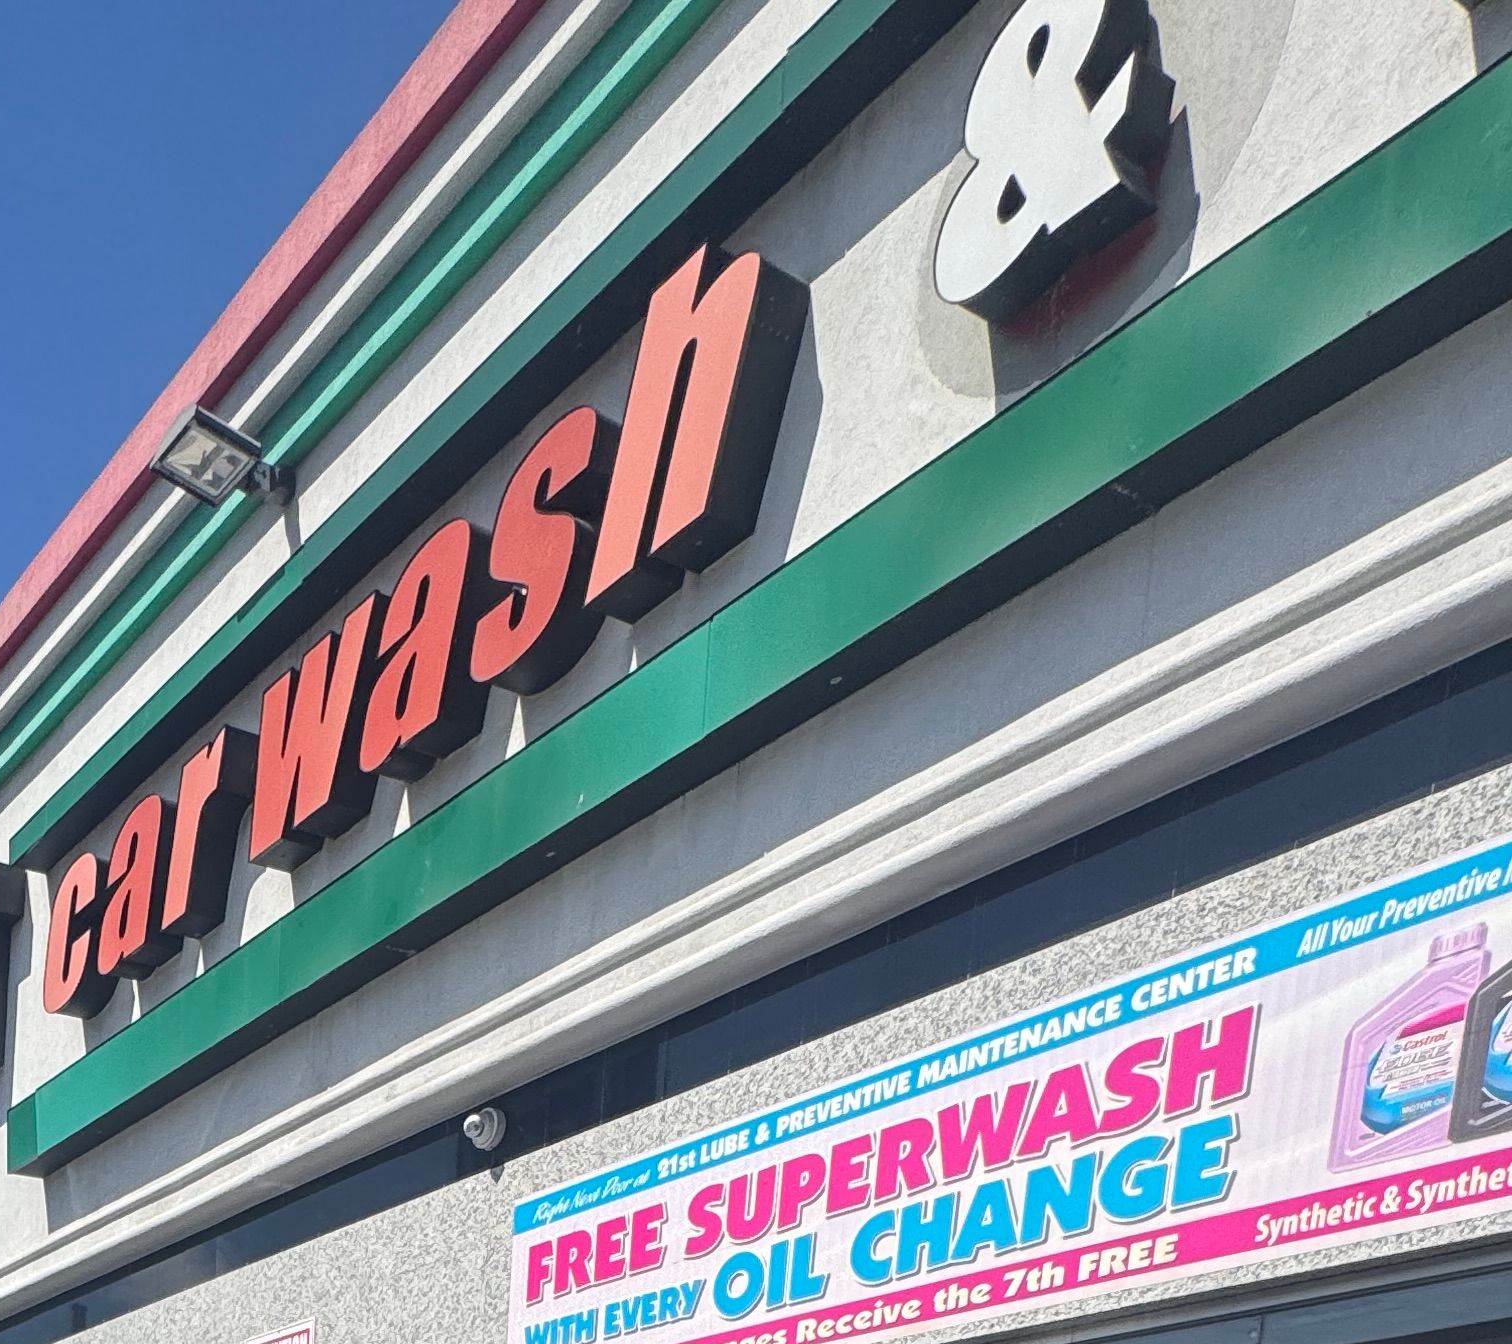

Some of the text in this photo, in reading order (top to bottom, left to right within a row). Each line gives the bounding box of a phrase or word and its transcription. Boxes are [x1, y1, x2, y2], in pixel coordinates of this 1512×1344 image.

[1295, 921, 1330, 958] All
[1330, 911, 1379, 947] Your
[1379, 866, 1502, 929] Preventive
[657, 1157, 696, 1180] 21st
[699, 1131, 750, 1164] LUBE
[754, 1123, 770, 1145] &
[776, 1071, 912, 1138] PREVENTIVE
[918, 996, 1122, 1088] MAINTENANCE
[1130, 947, 1258, 1013] CENTER
[1403, 1030, 1448, 1051] Castrol
[525, 1003, 1262, 1306] FREE SUPERWASH
[1401, 1097, 1446, 1114] MOTOR OIL
[603, 1278, 706, 1340] EVERY
[713, 1231, 830, 1320] OIL
[849, 1114, 1240, 1288] CHANGE
[1254, 1192, 1377, 1247] Synthetic
[1380, 1185, 1402, 1214] &
[795, 1299, 929, 1344] Receive
[934, 1281, 991, 1313] the
[1003, 1261, 1065, 1299] 7th
[1077, 1233, 1180, 1283] FREE
